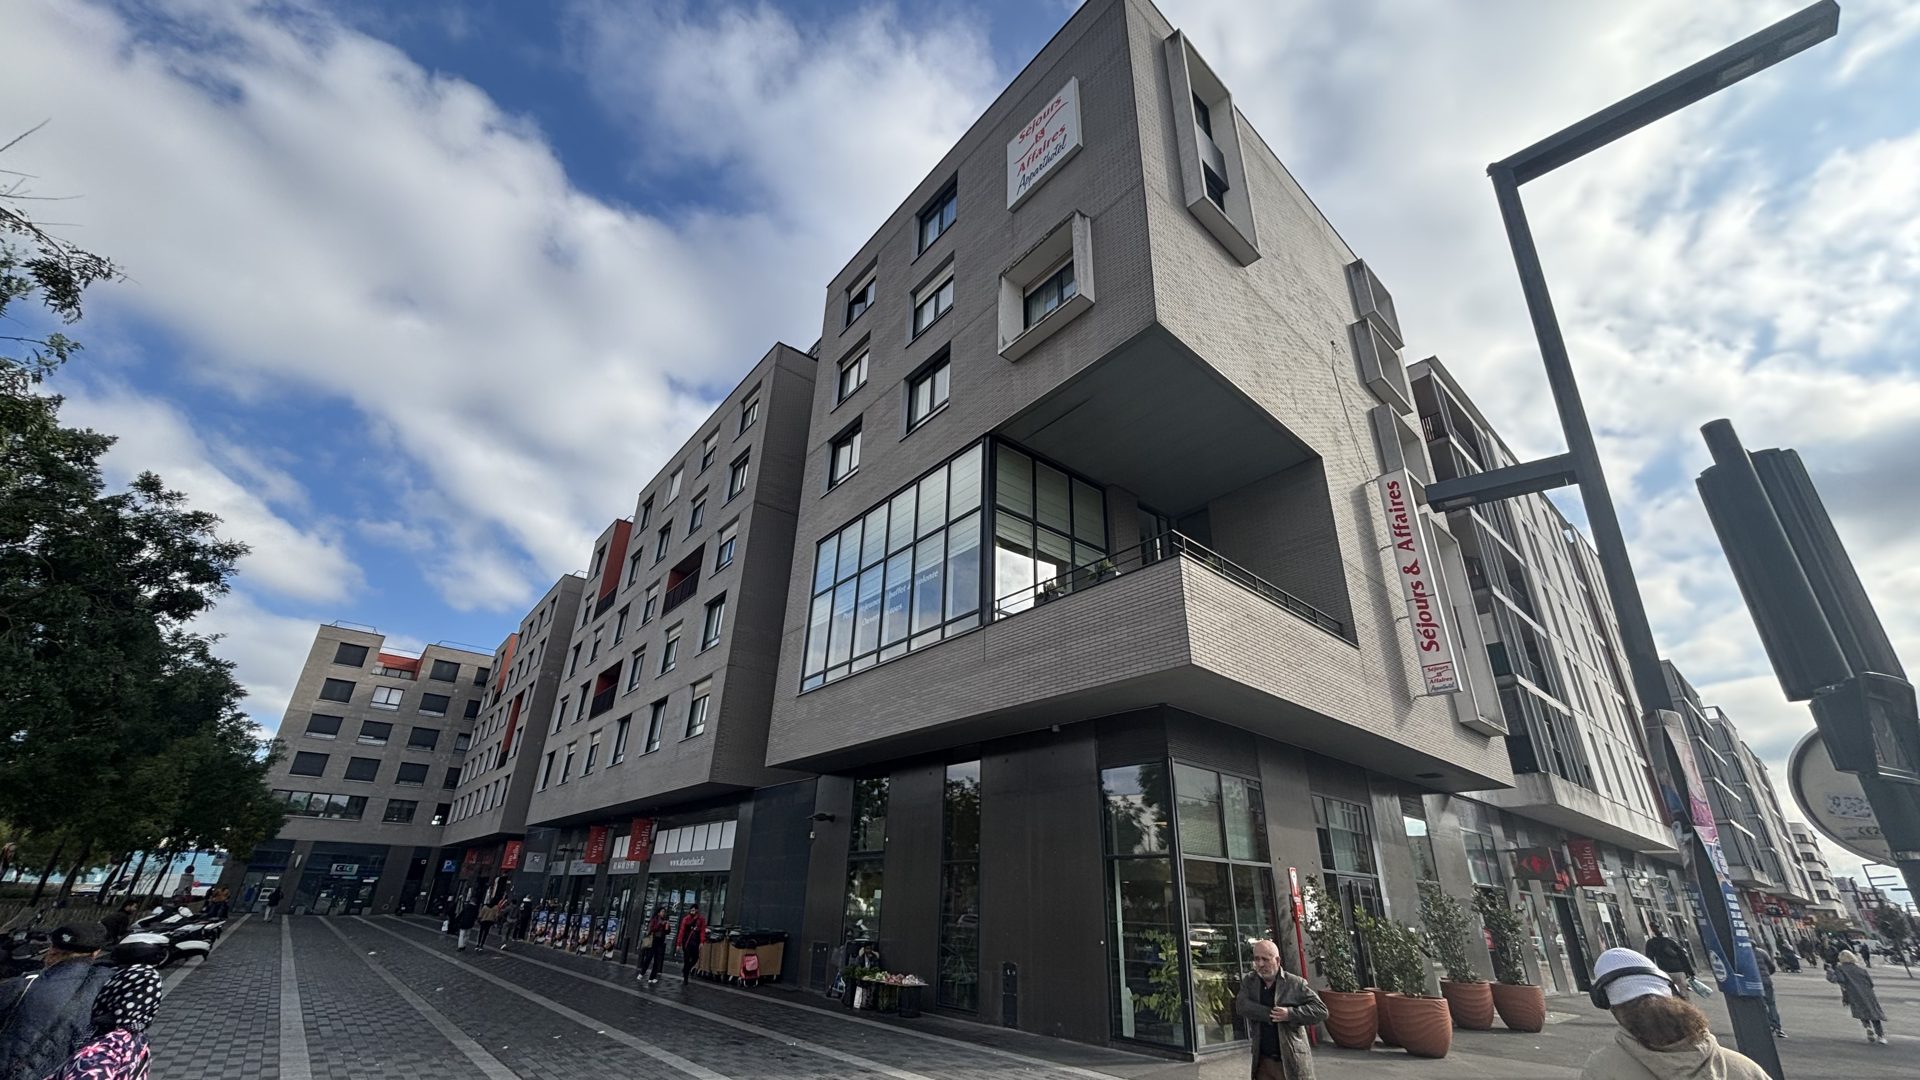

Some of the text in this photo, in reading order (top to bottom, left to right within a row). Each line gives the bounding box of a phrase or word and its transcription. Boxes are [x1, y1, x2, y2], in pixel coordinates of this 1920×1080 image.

[1017, 123, 1066, 176] Affaires
[1386, 480, 1440, 652] Séjours & Affaires
[443, 860, 452, 869] P
